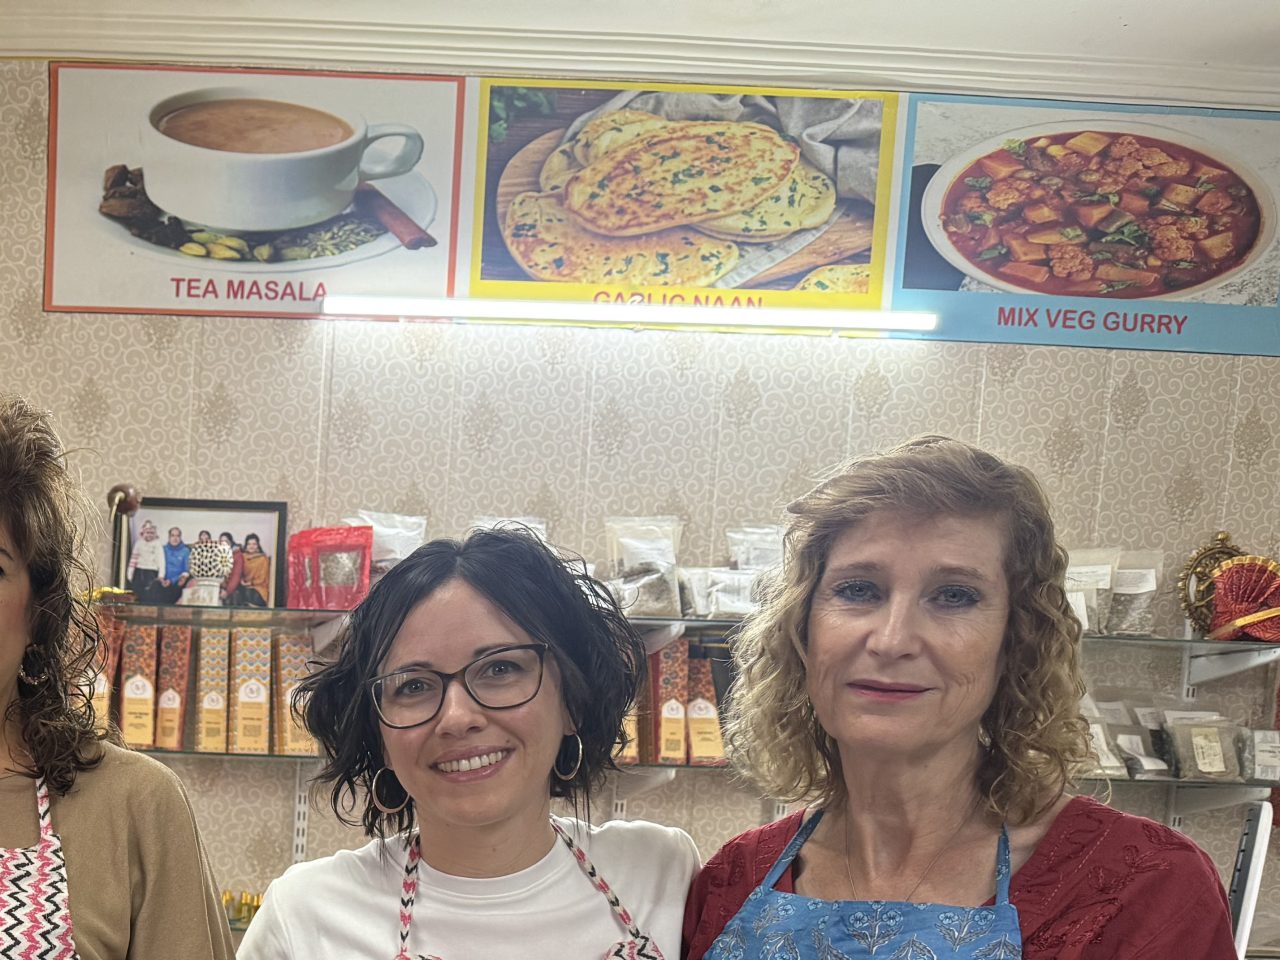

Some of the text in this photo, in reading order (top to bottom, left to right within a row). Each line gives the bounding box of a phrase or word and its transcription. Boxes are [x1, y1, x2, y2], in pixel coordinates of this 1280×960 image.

[171, 278, 327, 302] TEA MASALA
[997, 307, 1188, 335] MIX VEG GURRY
